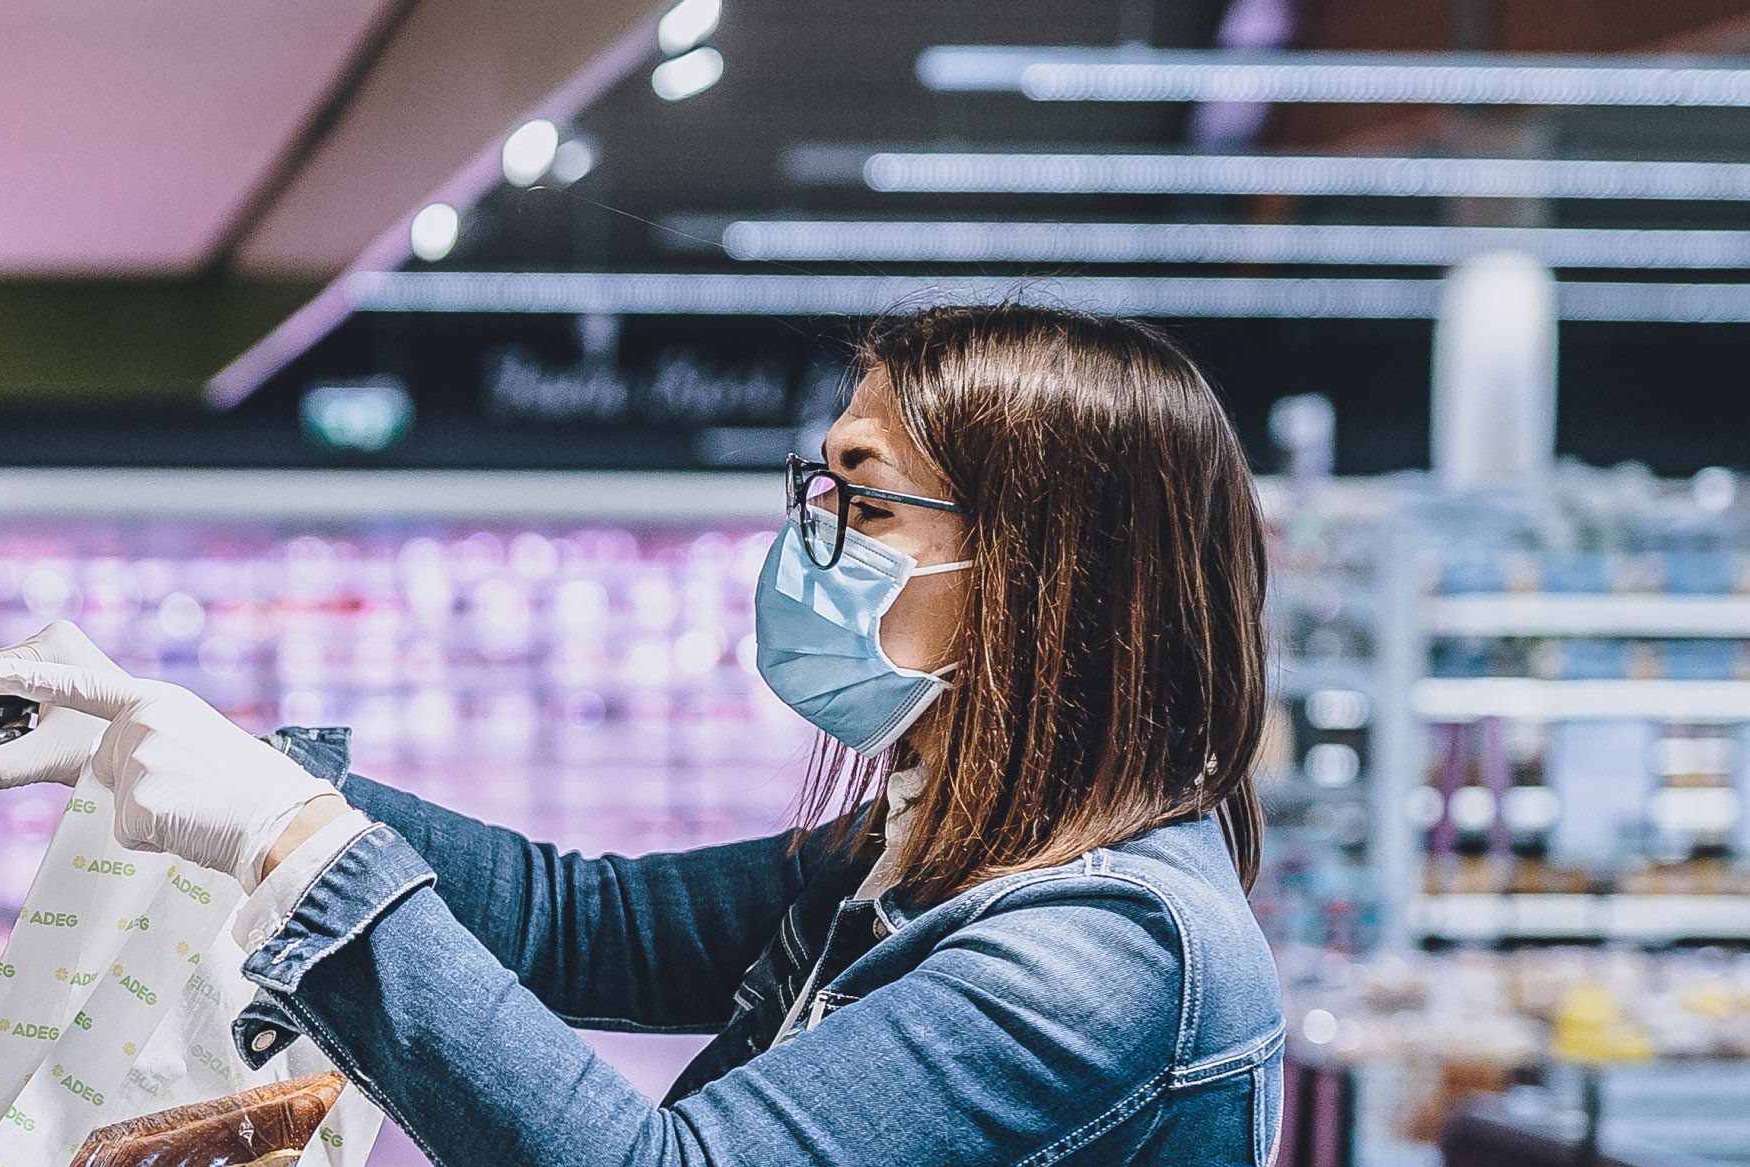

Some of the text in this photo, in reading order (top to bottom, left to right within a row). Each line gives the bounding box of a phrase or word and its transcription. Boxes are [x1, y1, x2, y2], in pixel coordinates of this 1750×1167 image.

[87, 859, 136, 877] ADEG
[171, 873, 212, 905] ADEG
[29, 910, 79, 928] ADEG
[119, 975, 158, 1006] ADEG
[12, 1022, 60, 1041] ADEG
[60, 1074, 105, 1107] ADEG
